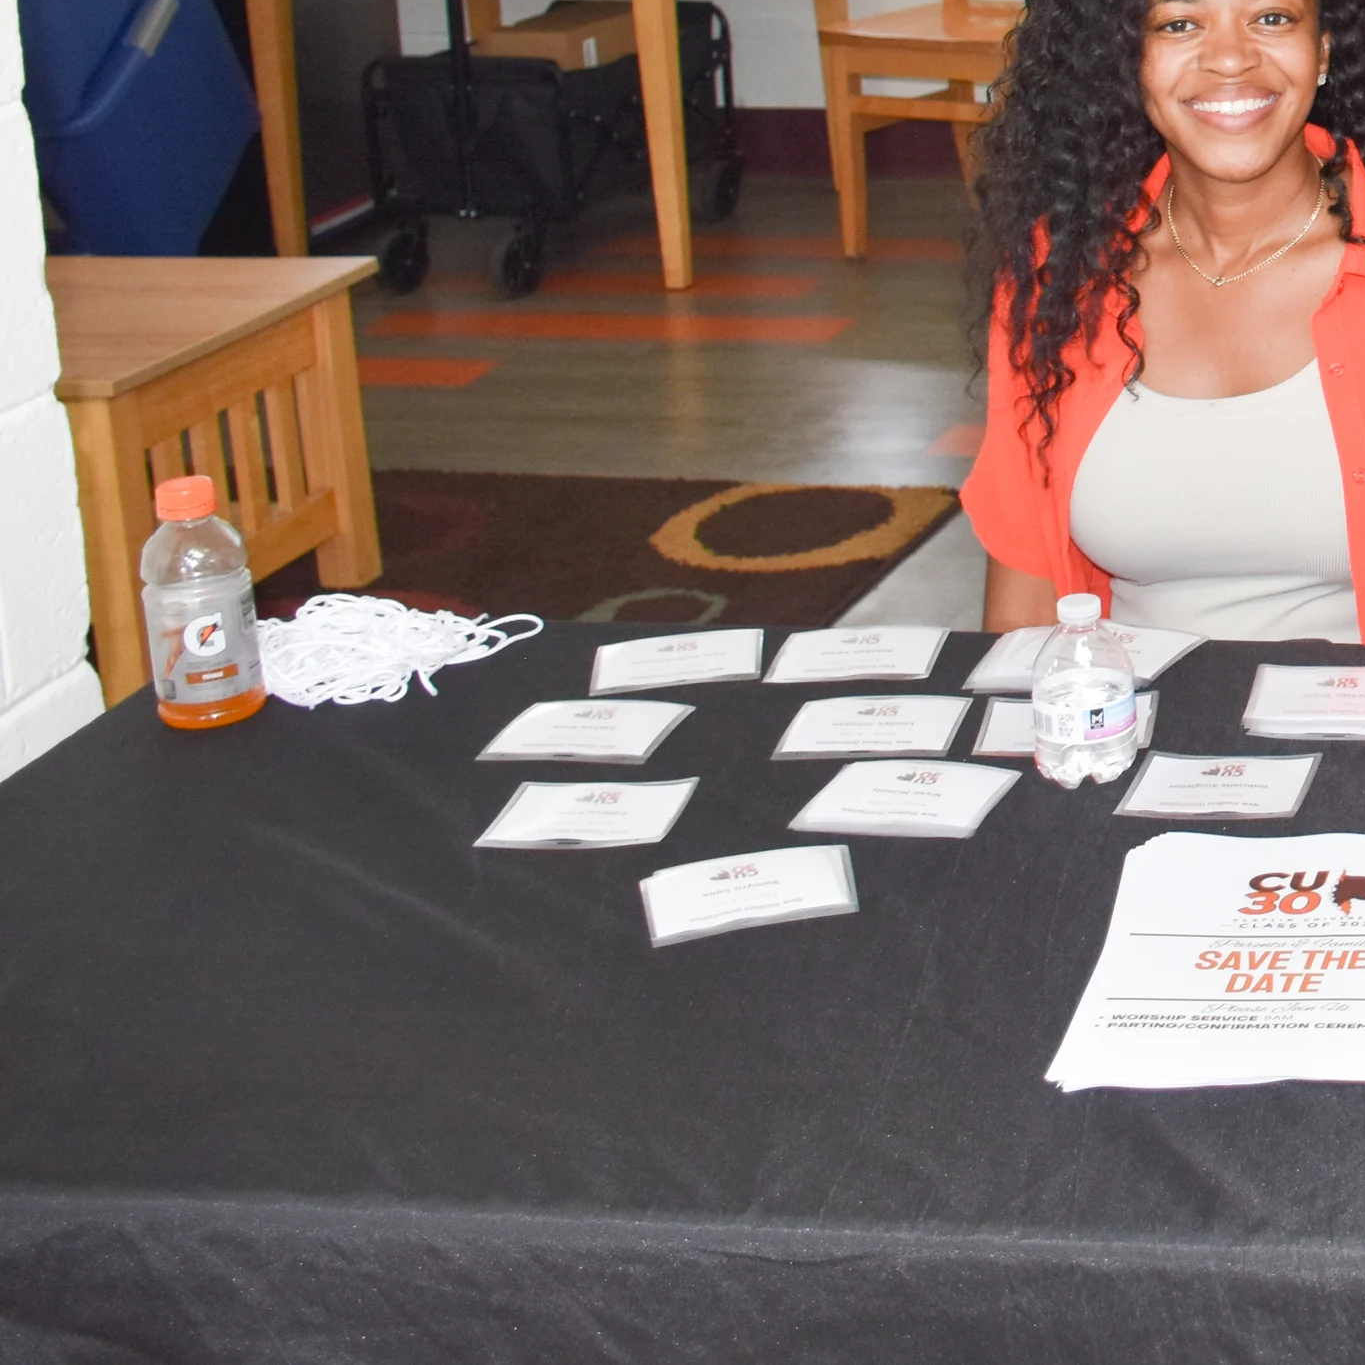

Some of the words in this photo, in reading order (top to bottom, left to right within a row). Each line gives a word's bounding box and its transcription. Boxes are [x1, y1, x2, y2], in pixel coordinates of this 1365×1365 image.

[183, 611, 227, 656] G
[1248, 870, 1330, 892] CU
[1237, 891, 1321, 915] 30
[1209, 938, 1287, 949] Parents
[1195, 950, 1294, 971] SAVE
[1224, 973, 1325, 993] DATE
[1201, 1002, 1269, 1014] Please
[1107, 1022, 1309, 1030] PARTING/CONFIRMATION
